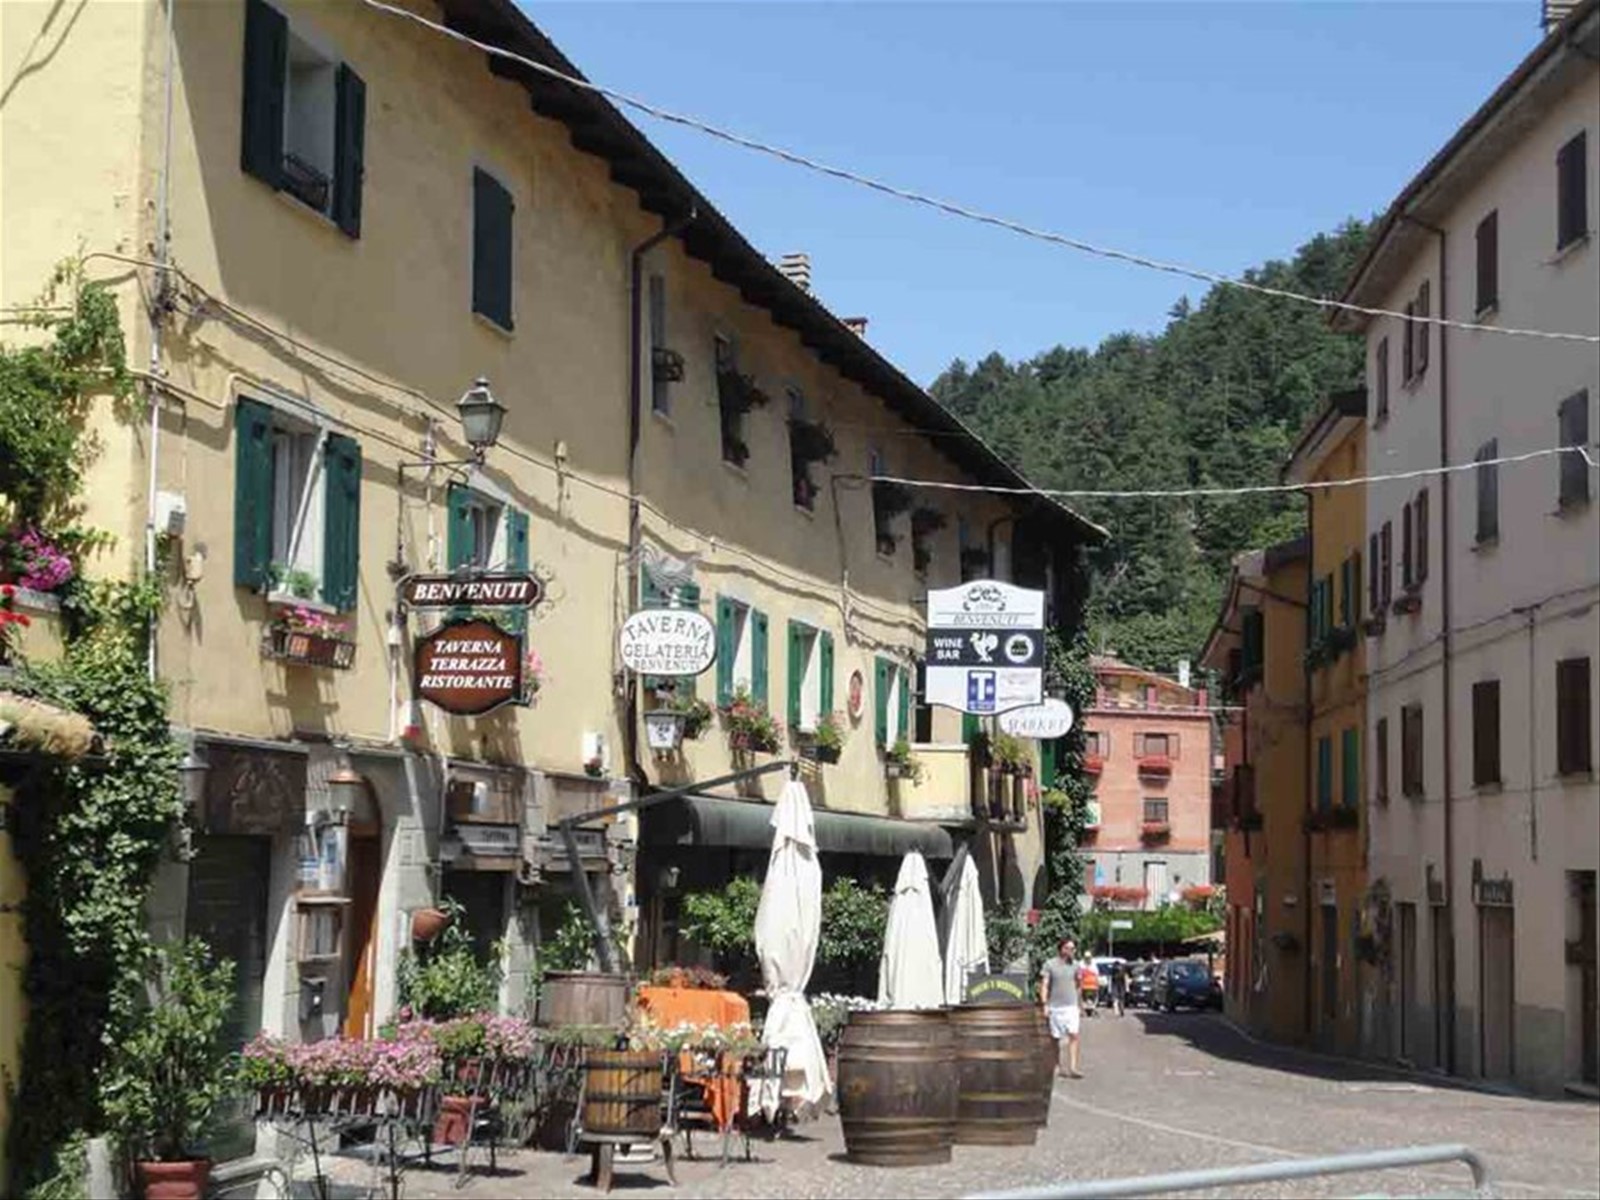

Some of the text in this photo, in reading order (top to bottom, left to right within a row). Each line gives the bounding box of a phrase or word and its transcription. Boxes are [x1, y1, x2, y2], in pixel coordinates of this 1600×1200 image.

[413, 581, 529, 601] BENVENUTI
[625, 616, 711, 642] TAVERNA
[433, 640, 502, 654] TAVERNA
[623, 643, 709, 658] GELATERIA
[934, 638, 963, 649] WINE
[937, 650, 961, 660] BAR
[430, 658, 506, 671] TERRAZZA
[420, 675, 515, 689] RISTORANTE
